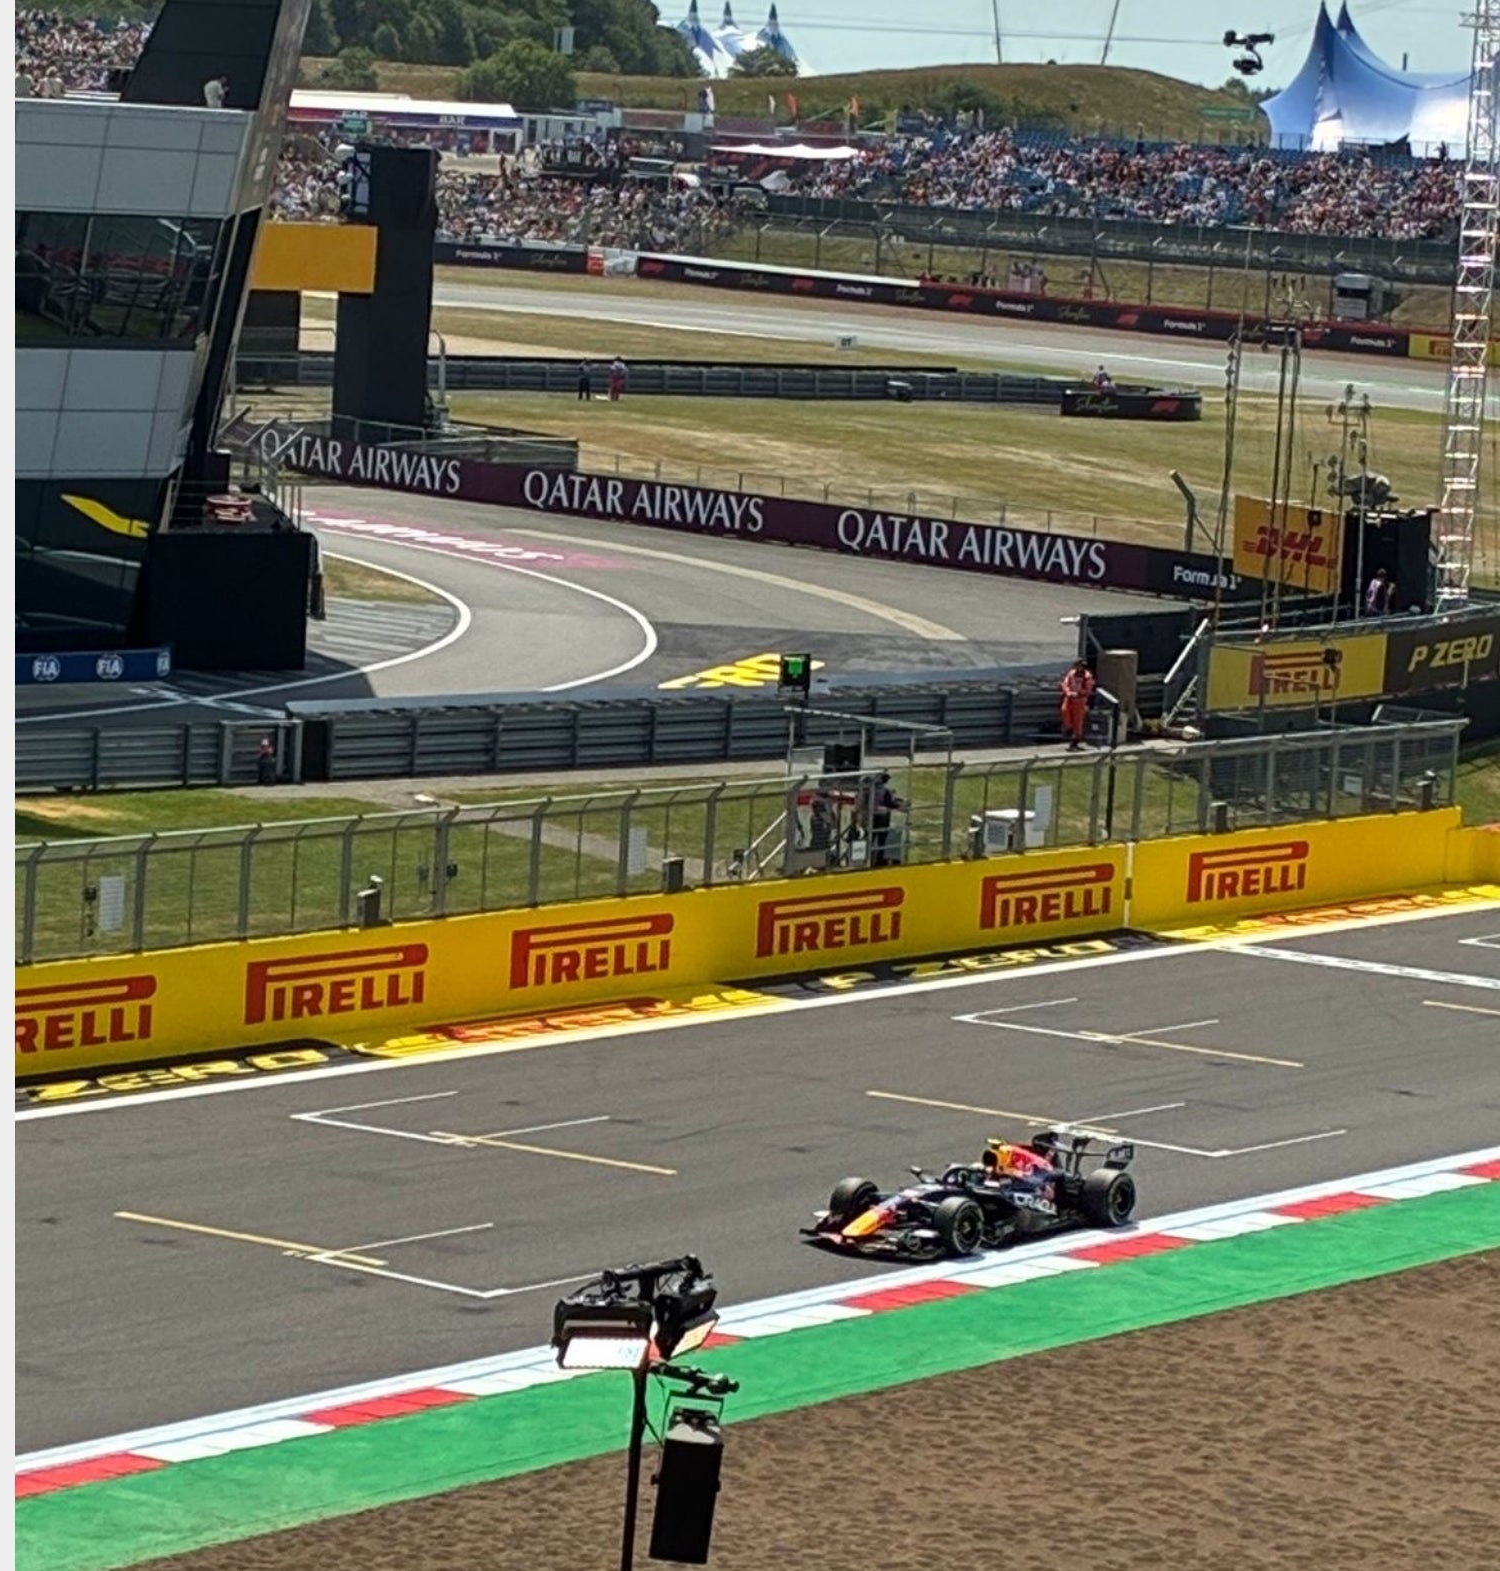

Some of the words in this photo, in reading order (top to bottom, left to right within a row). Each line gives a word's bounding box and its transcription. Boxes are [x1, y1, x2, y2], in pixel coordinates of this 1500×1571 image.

[439, 115, 466, 125] BAR
[348, 444, 460, 493] AIRWAYS
[524, 470, 624, 515] QATAR
[632, 483, 764, 532] AIRWAYS
[837, 510, 950, 560] QATAR
[958, 526, 1106, 578] AIRWAYS
[33, 659, 58, 677] FIA
[97, 659, 121, 676] FIA
[1408, 645, 1429, 672] P
[1429, 633, 1493, 668] ZERO
[979, 863, 1115, 930] PIRELLI
[1186, 840, 1310, 902] PIRELLI
[509, 913, 675, 990] PIRELLI
[755, 887, 906, 958] PIRELLI
[15, 975, 158, 1054] RELLI
[243, 943, 429, 1025] PIRELLI
